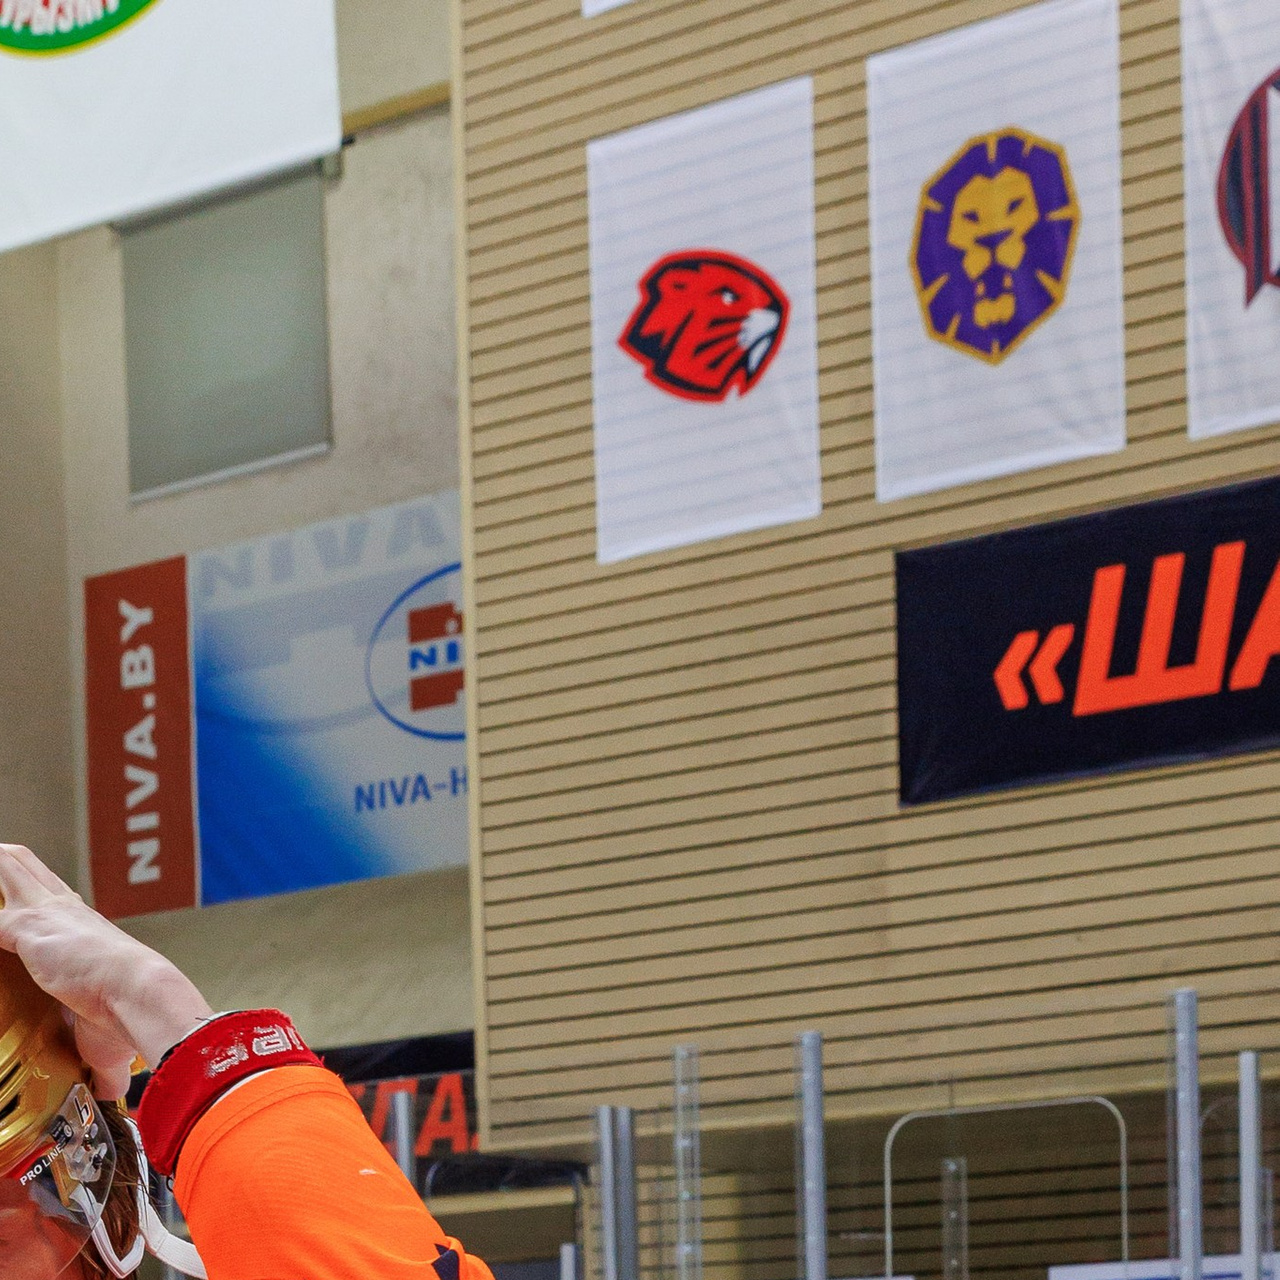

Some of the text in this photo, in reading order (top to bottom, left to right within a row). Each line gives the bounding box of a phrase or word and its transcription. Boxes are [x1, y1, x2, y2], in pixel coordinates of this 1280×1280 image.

[198, 503, 447, 598] NIVA
[119, 598, 161, 886] NIVA.BY
[20, 1143, 64, 1186] PRO LINE
